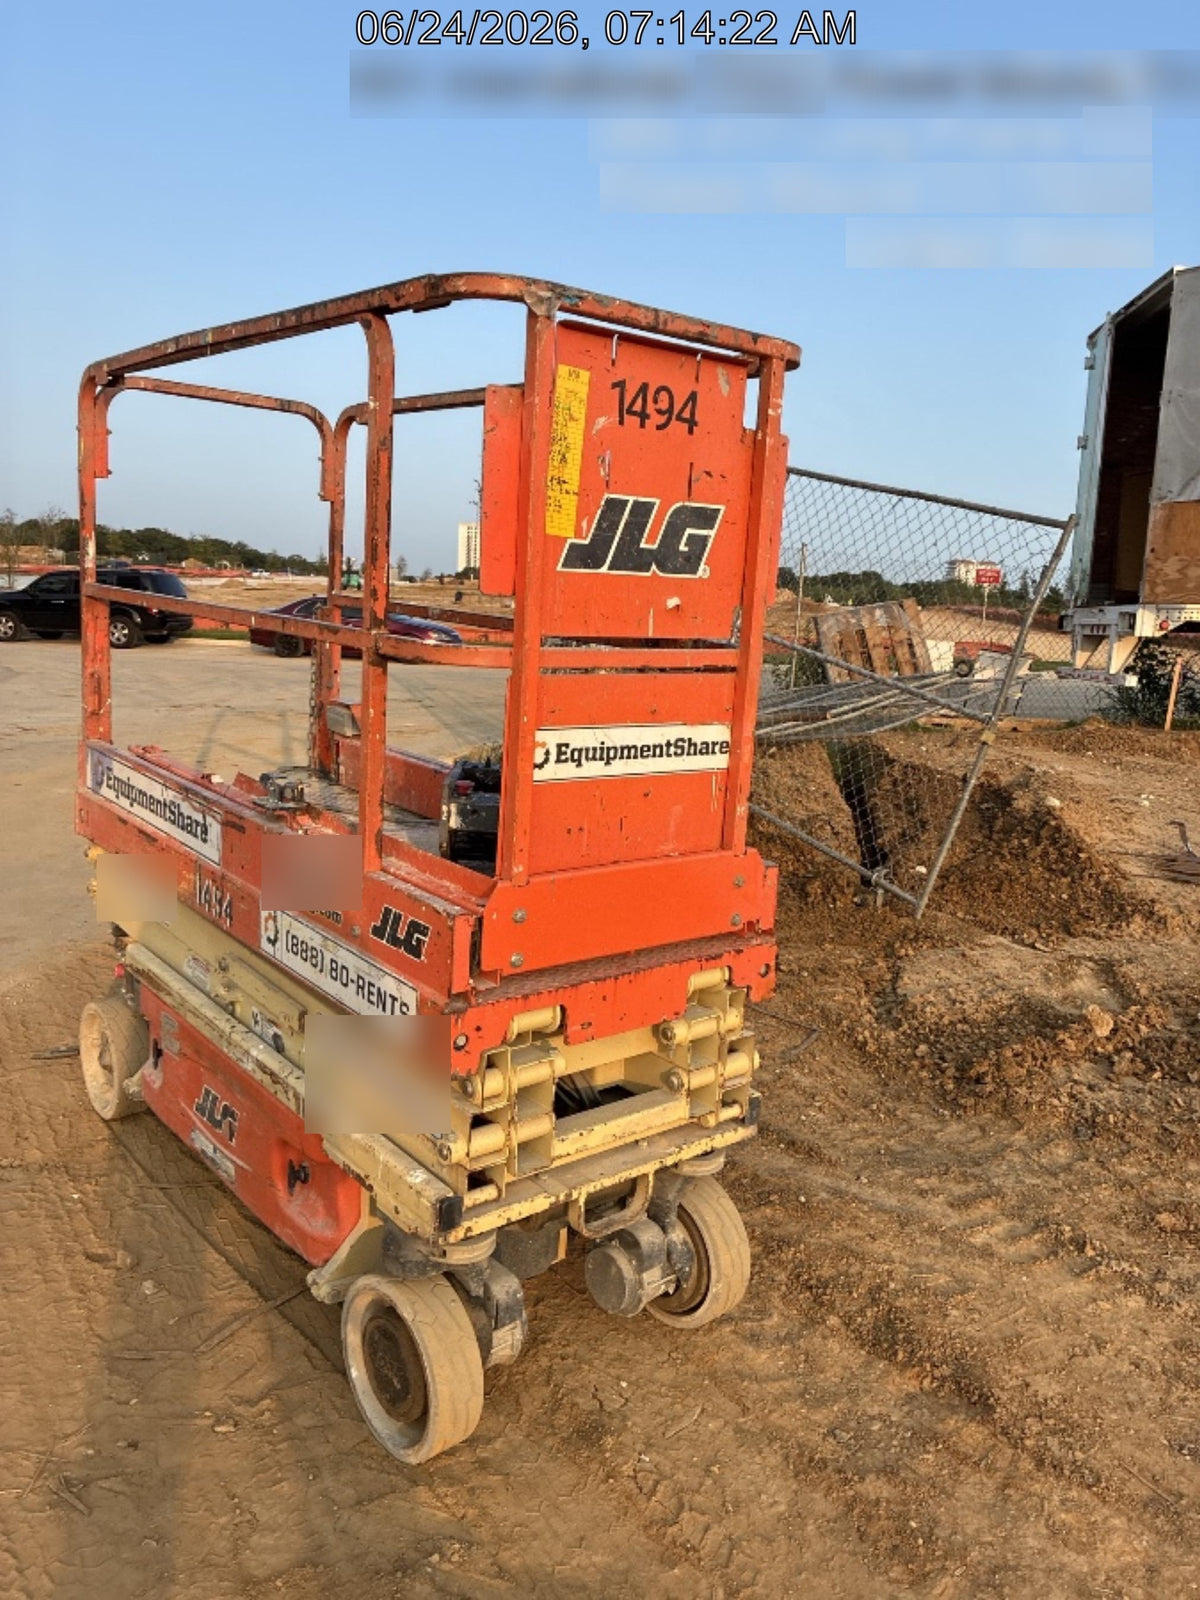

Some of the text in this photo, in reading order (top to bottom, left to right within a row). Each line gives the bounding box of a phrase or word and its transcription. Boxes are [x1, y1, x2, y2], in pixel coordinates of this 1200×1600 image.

[611, 379, 698, 435] 1494
[554, 737, 730, 768] EquipmentShare
[105, 766, 209, 844] EquipmentShare
[285, 929, 325, 974] (888)
[369, 904, 433, 962] JLG
